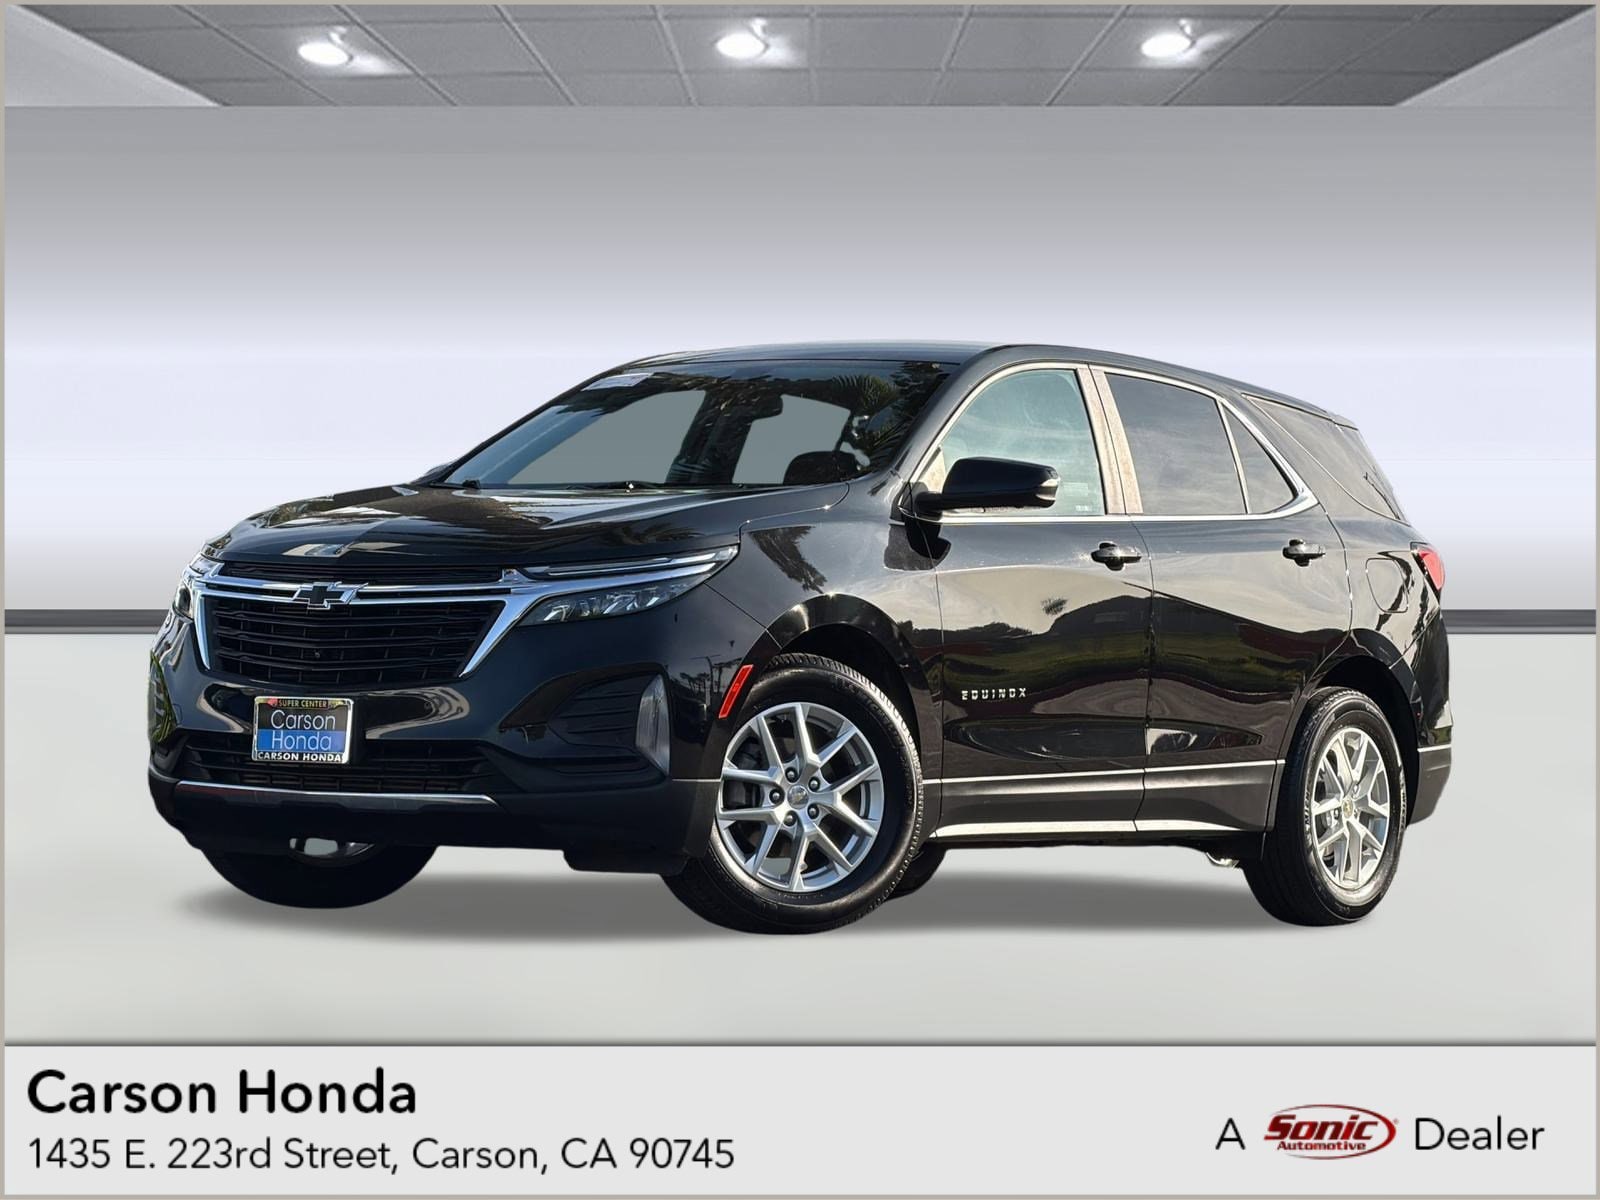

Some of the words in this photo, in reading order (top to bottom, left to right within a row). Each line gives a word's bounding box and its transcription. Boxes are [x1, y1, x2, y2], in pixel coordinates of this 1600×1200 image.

[961, 687, 1026, 700] EQUINOX
[301, 700, 327, 708] CENTER
[270, 709, 336, 730] Carson
[271, 730, 332, 751] Honda
[257, 752, 299, 761] CARSON
[302, 753, 340, 762] HONDA
